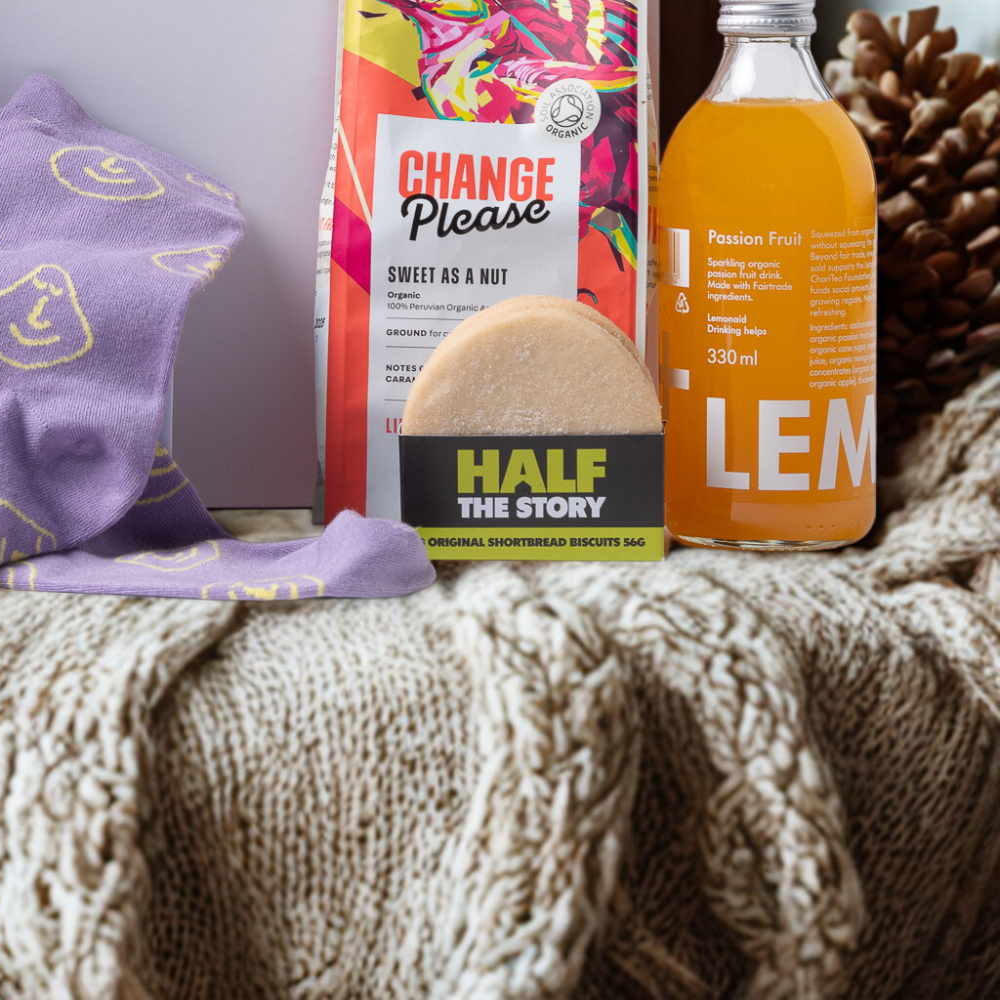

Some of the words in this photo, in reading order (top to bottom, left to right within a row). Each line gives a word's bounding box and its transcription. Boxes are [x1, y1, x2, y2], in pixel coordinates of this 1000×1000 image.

[540, 102, 551, 122] SOIL
[550, 84, 595, 120] ASSOCIATION
[546, 122, 589, 139] ORGANIC
[398, 150, 556, 202] CHANGE
[401, 193, 551, 242] Please
[709, 229, 763, 246] Passion
[769, 231, 802, 246] Fruit
[811, 229, 846, 239] Squeezed
[811, 241, 837, 249] without
[811, 252, 838, 262] Beyond
[708, 257, 745, 270] Sparkling
[748, 260, 780, 270] organic
[811, 263, 826, 272] sold
[828, 263, 855, 273] supports
[388, 266, 436, 284] SWEET
[441, 267, 460, 285] AS
[465, 268, 475, 285] A
[480, 268, 508, 286] NUT
[708, 270, 737, 279] passion
[740, 270, 757, 279] fruit
[759, 271, 783, 280] drink.
[810, 274, 843, 283] ChariTea
[708, 280, 731, 289] Made
[733, 280, 751, 290] with
[753, 282, 793, 290] Fairtrade
[810, 285, 830, 294] funds
[832, 284, 850, 294] social
[387, 292, 421, 301] Organic
[708, 291, 754, 302] ingredients.
[387, 302, 408, 311] 100%
[410, 303, 445, 312] Peruvian
[446, 303, 478, 314] Organic
[810, 297, 840, 308] growing
[708, 313, 747, 323] Lemonaid
[708, 324, 741, 337] Drinking
[744, 326, 767, 337] helps
[810, 322, 849, 333] Ingredients:
[386, 329, 427, 338] GROUND
[429, 330, 442, 338] for
[810, 334, 837, 344] organic
[810, 345, 837, 356] organic
[707, 348, 737, 365] 330
[740, 349, 758, 366] ml
[809, 357, 828, 367] juice,
[829, 355, 853, 366] organic
[386, 364, 417, 373] NOTES
[809, 367, 851, 376] concentrates
[809, 378, 837, 389] organic
[457, 448, 607, 494] HALF
[457, 496, 510, 520] THE
[516, 496, 607, 520] STORY
[428, 537, 486, 548] ORIGINAL
[487, 537, 567, 548] SHORTBREAD
[570, 537, 621, 548] BISCUITS
[624, 537, 646, 548] 56G
